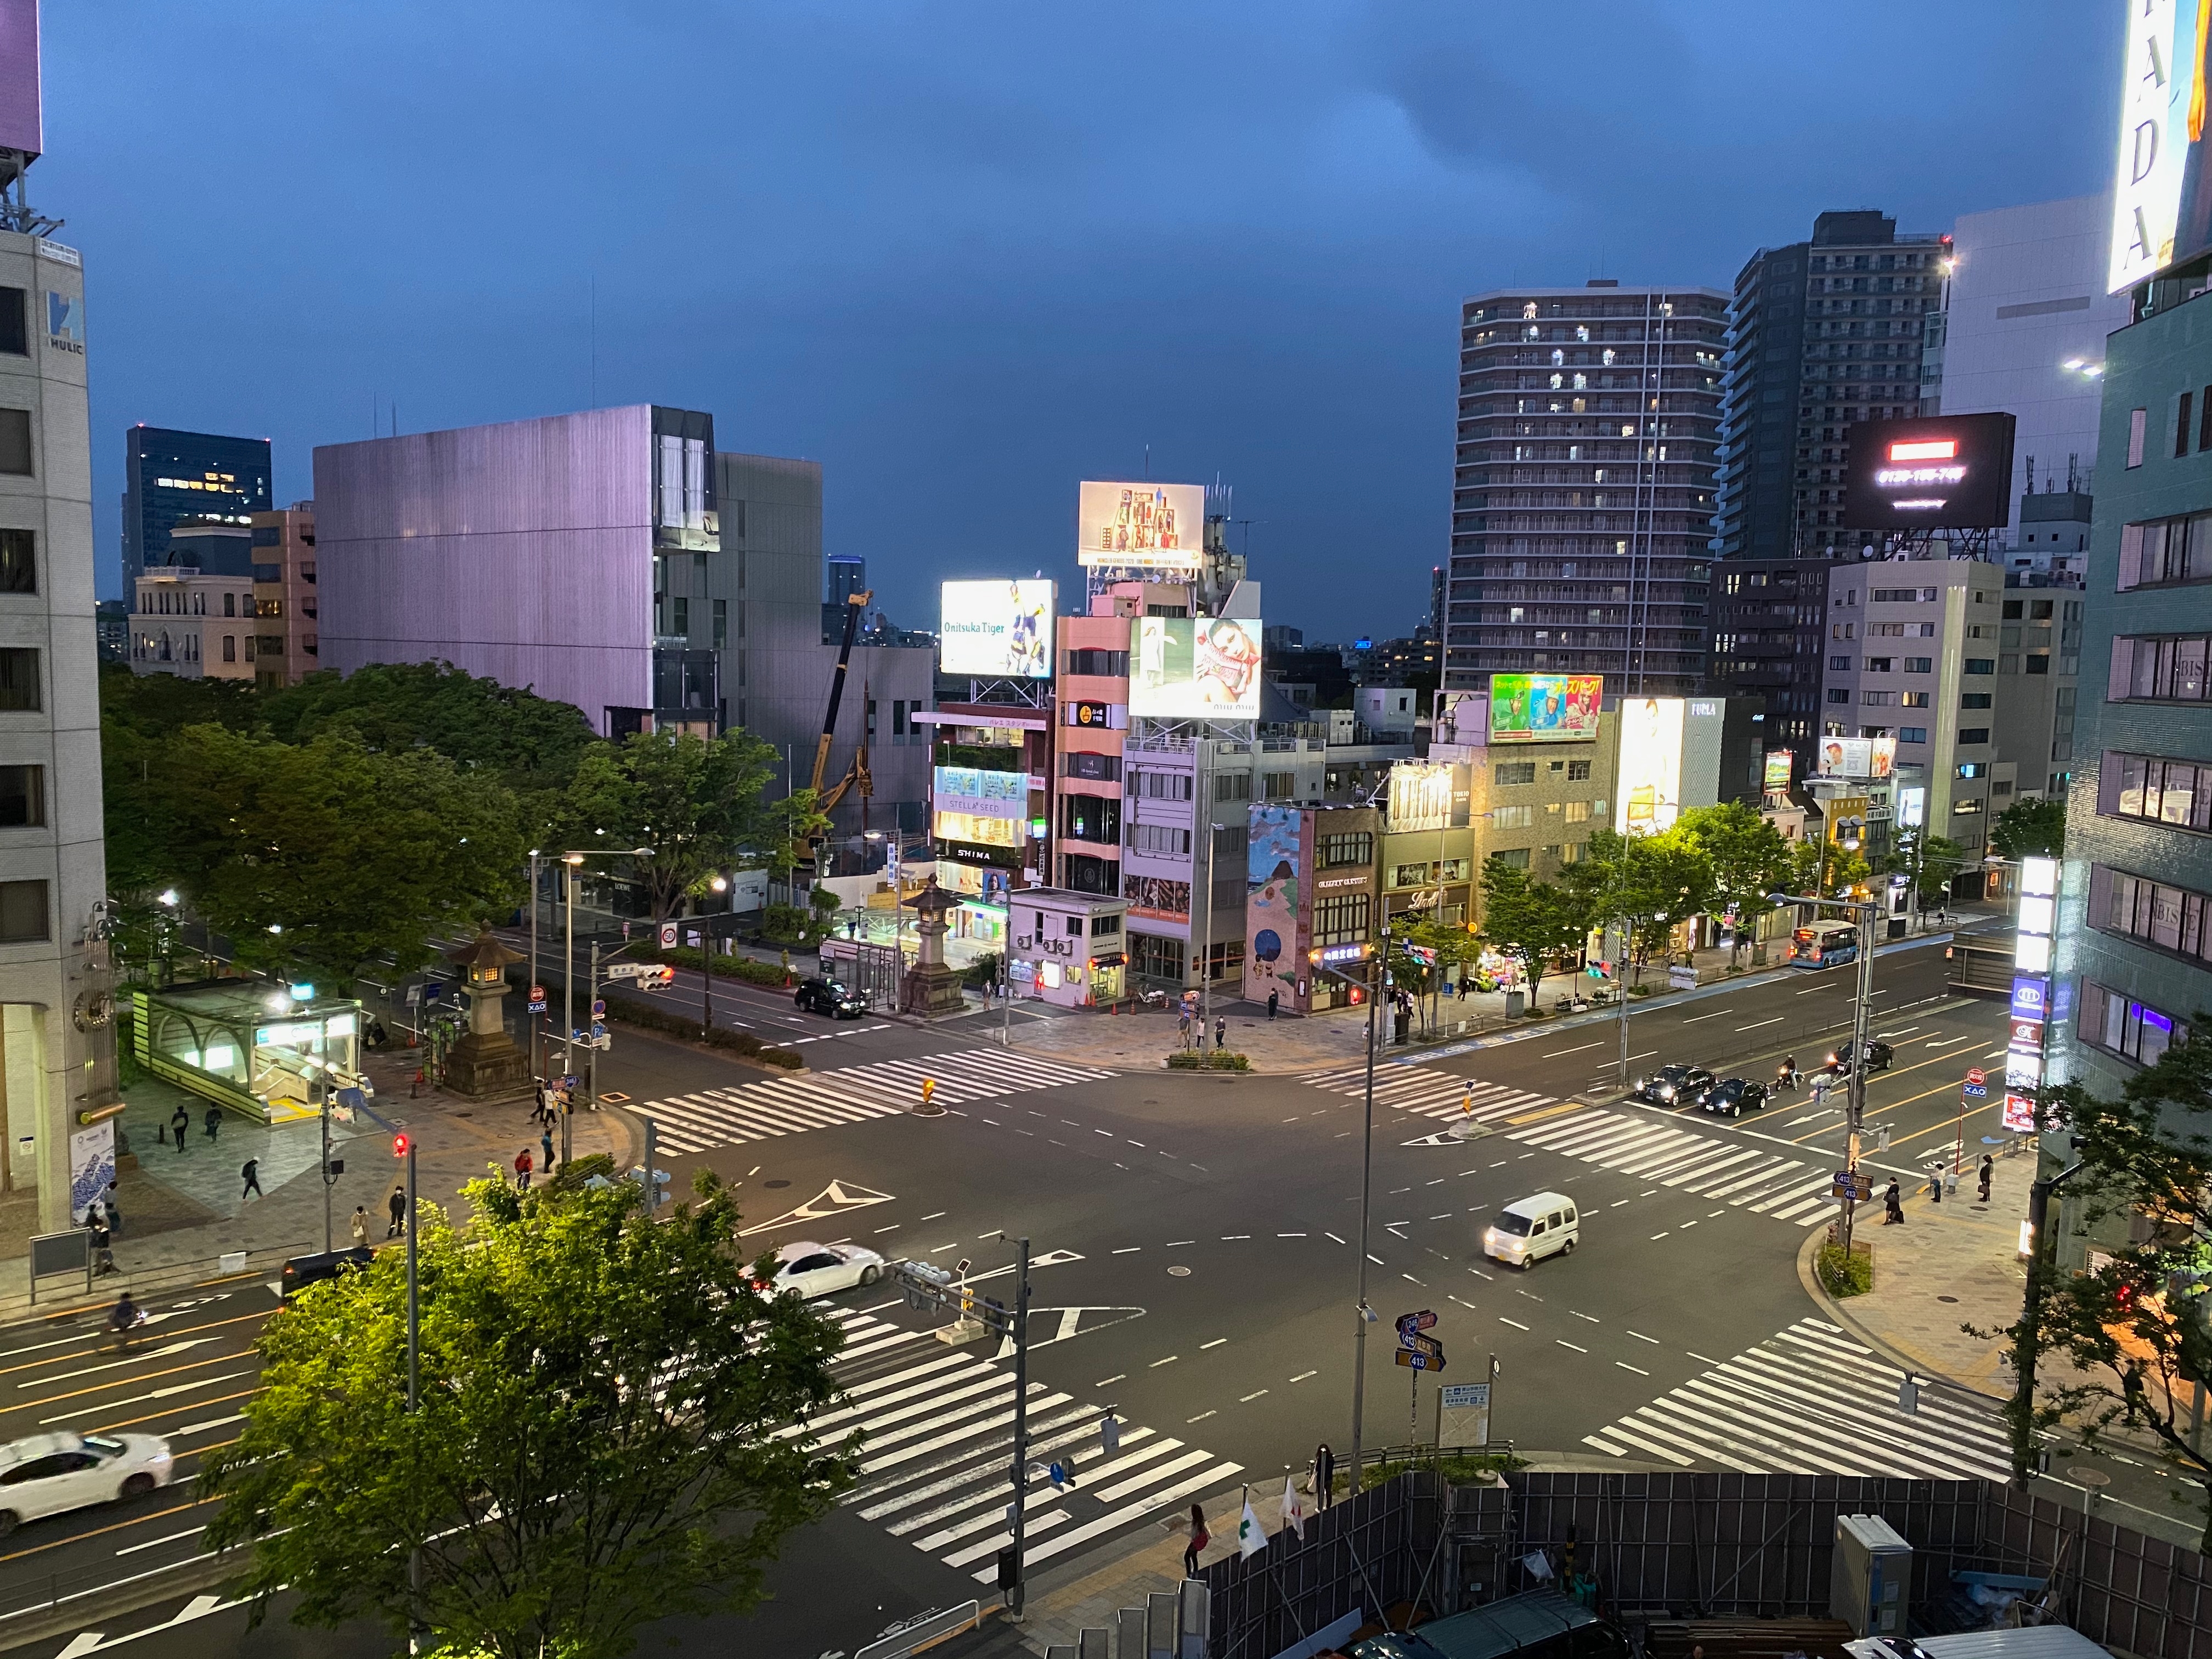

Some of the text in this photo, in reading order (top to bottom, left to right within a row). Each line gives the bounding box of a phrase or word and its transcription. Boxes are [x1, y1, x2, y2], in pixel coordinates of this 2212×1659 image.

[2123, 0, 2167, 271] ADA
[50, 338, 82, 355] HULIC
[944, 622, 1005, 635] Onitsuka Tiger
[980, 804, 999, 812] SEED
[957, 849, 990, 860] SHIMA
[614, 882, 631, 892] LOEWE
[1408, 1318, 1418, 1328] 246
[1404, 1335, 1414, 1346] 413
[1411, 1357, 1424, 1367] 413
